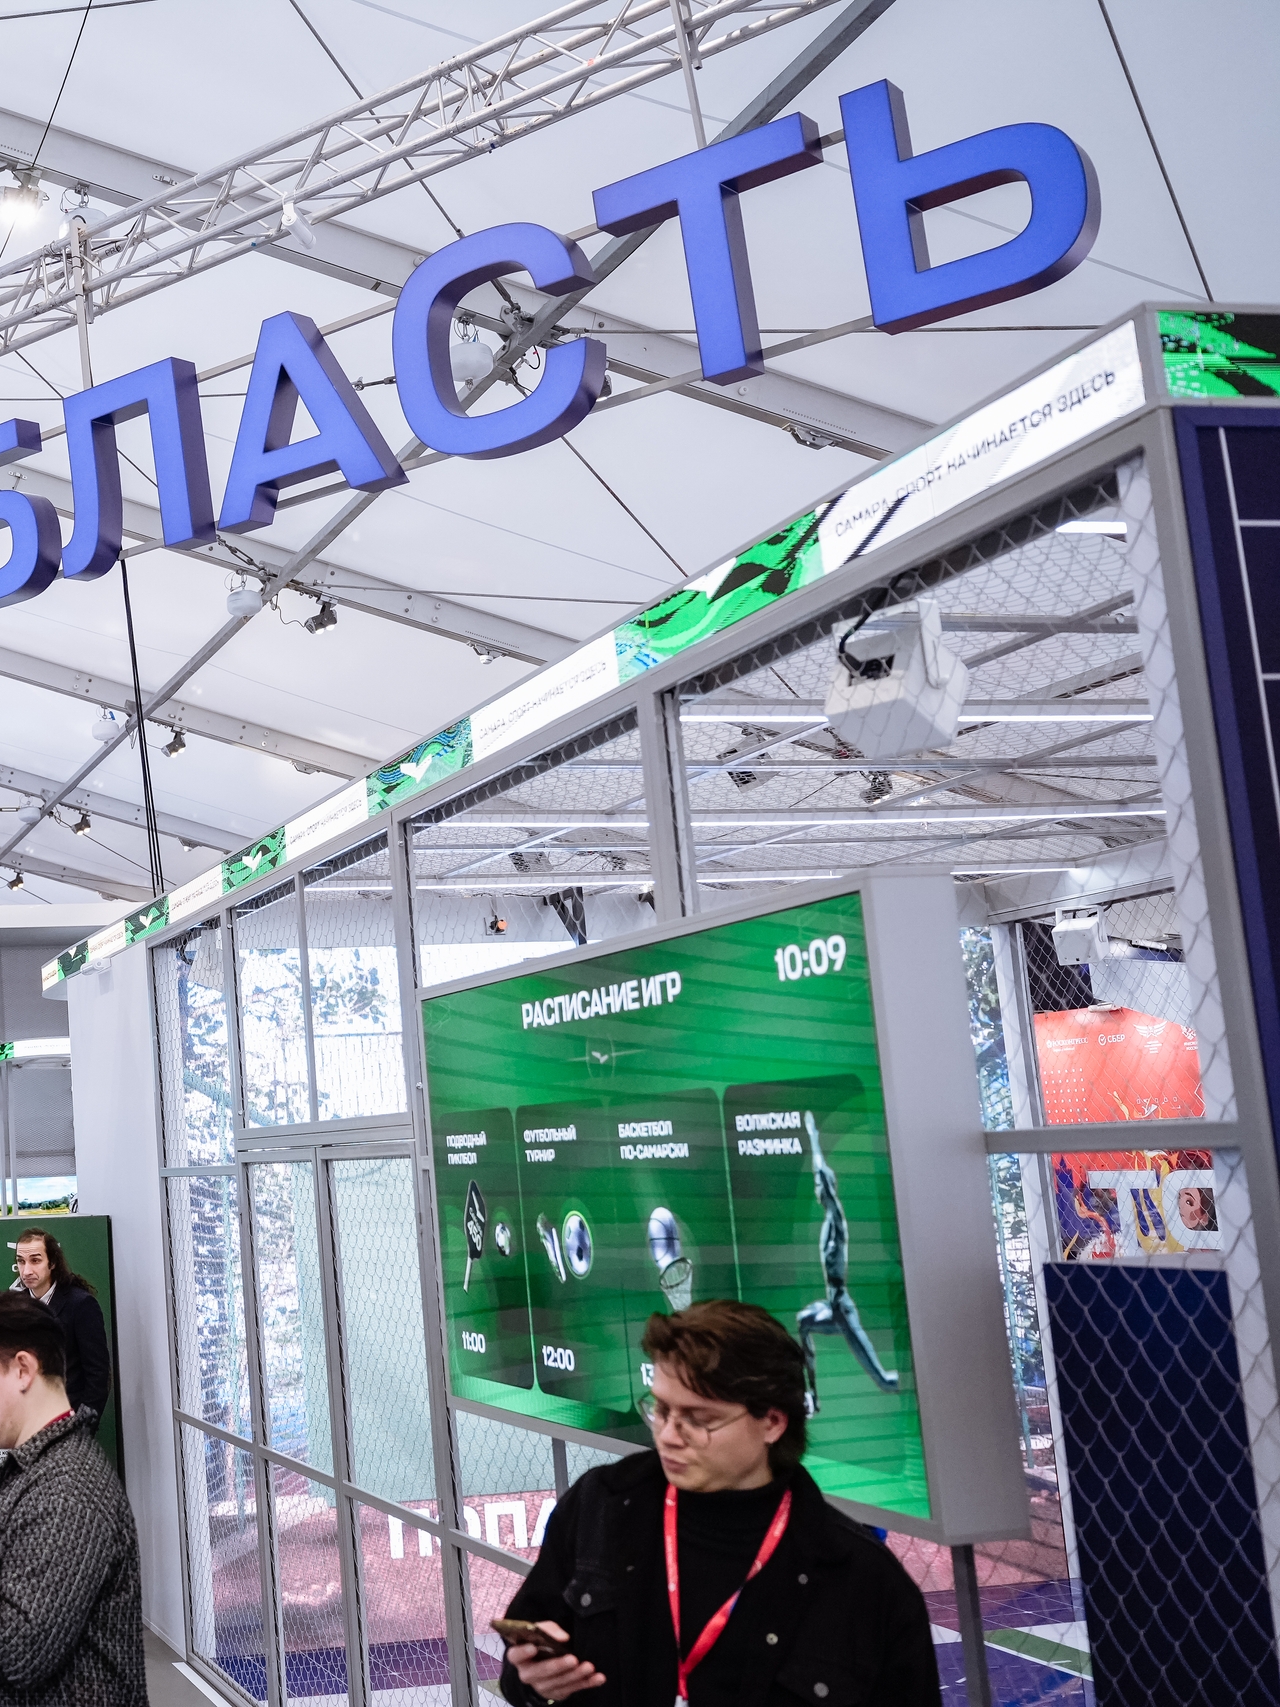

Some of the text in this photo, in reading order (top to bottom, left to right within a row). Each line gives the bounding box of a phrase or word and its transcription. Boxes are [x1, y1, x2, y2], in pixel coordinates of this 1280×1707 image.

[896, 464, 942, 501] СПОРТ
[947, 403, 1052, 471] НАЧИНАЕТСЯ
[1058, 370, 1116, 414] ЗДЕСЬ
[774, 935, 847, 982] 10:09
[521, 971, 682, 1029] РАСПИСАНИЕ ИГР
[1107, 1034, 1126, 1043] СБЕР
[618, 1120, 673, 1139] БАСКЕТБОЛ
[735, 1111, 801, 1132] ВОЛЖСКАЯ
[446, 1131, 487, 1149] ПОДВОДНЫЙ
[523, 1124, 577, 1143] ФУТБОЛЬНЫЙ
[525, 1149, 556, 1163] ТУРНИР
[620, 1143, 690, 1160] ПО-САМАРСКИ
[738, 1137, 803, 1156] РАЗМИНКА
[461, 1330, 486, 1354] 11:00
[541, 1345, 575, 1372] 12:00
